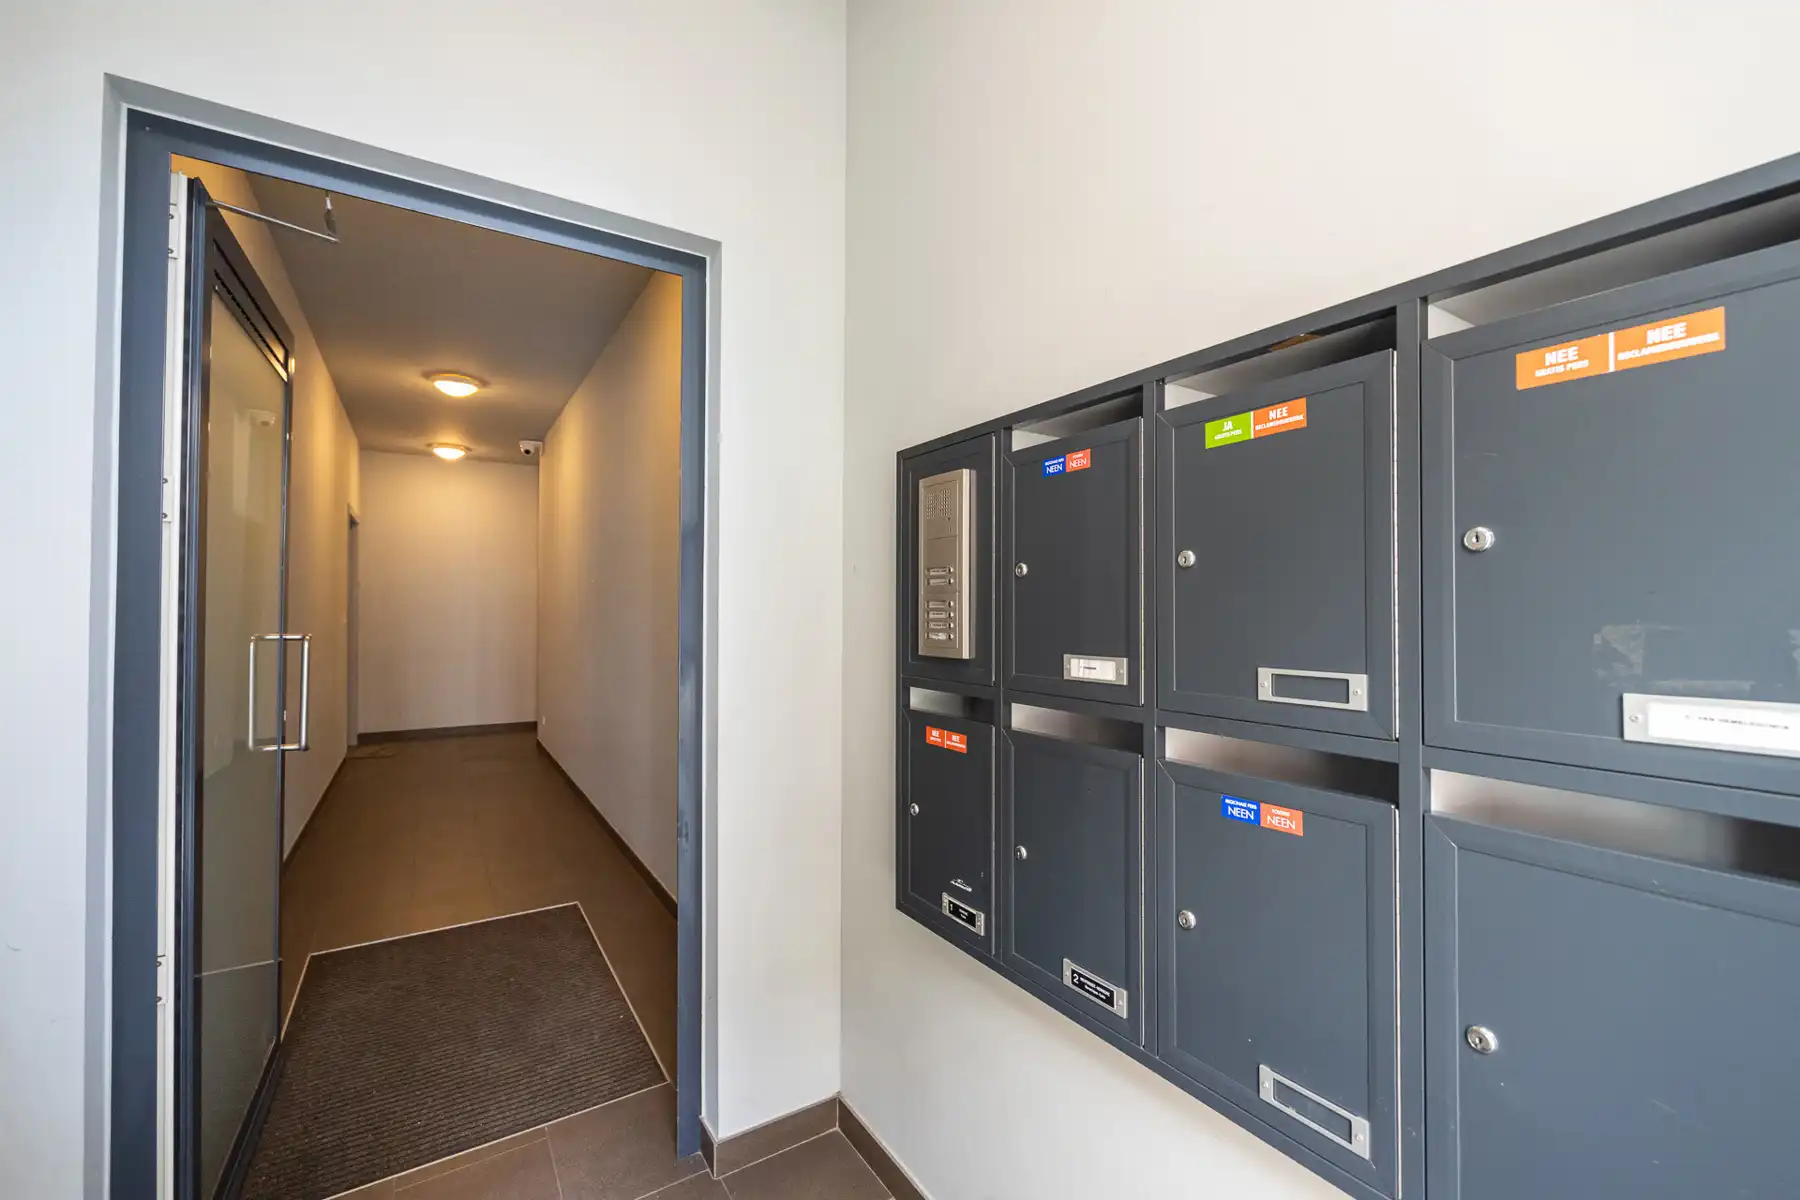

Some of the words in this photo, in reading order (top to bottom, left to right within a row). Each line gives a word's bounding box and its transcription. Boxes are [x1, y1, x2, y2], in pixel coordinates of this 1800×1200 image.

[1646, 322, 1687, 344] NEE
[1545, 346, 1579, 366] NEE
[1269, 406, 1289, 420] NEE
[1222, 420, 1233, 431] JA
[1046, 463, 1063, 474] NEEN
[1069, 457, 1087, 469] NEEN
[1228, 806, 1254, 820] NEEN
[1267, 815, 1296, 829] NEEN
[1073, 973, 1079, 984] 2
